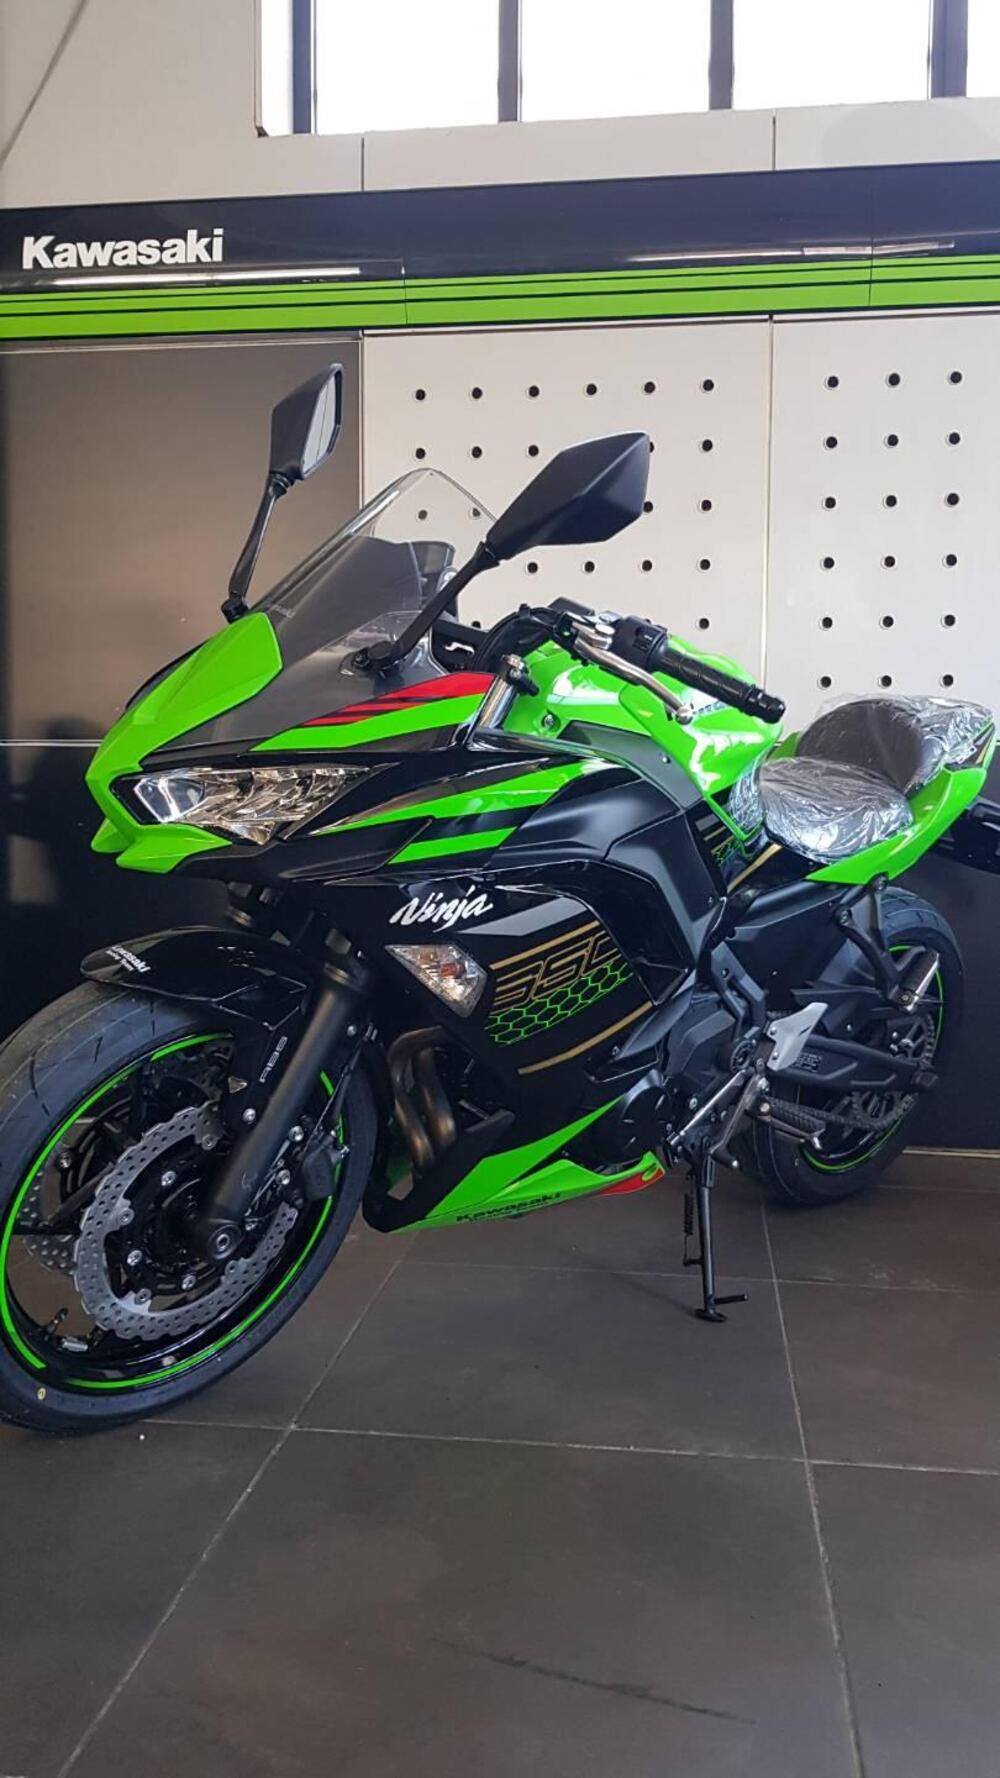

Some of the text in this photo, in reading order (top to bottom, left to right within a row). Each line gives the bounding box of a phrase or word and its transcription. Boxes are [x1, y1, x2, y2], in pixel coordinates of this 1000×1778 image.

[22, 228, 224, 270] Kawasaki
[388, 885, 494, 933] Ninja
[258, 1036, 289, 1084] ABS
